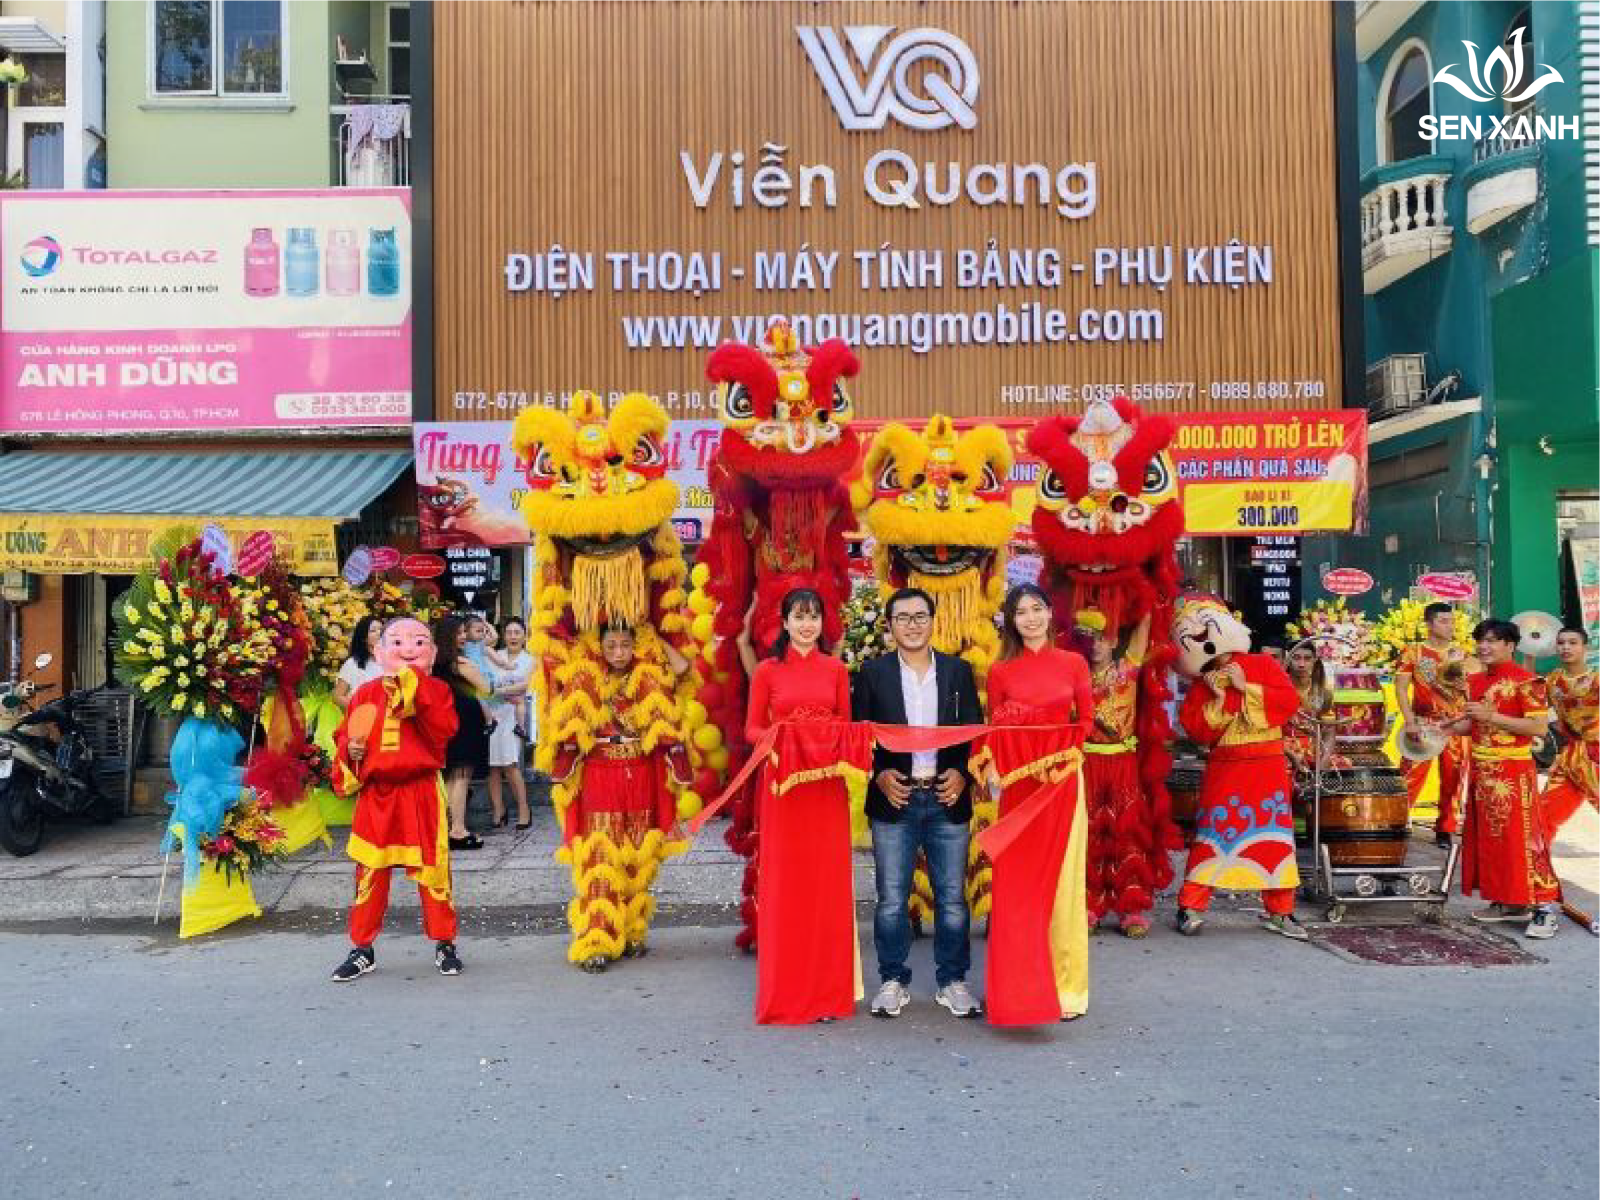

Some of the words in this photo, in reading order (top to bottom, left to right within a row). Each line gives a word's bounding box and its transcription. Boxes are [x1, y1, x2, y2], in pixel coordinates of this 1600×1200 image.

[680, 142, 837, 208] Viễn
[863, 149, 1098, 219] Quang
[71, 248, 218, 265] TOTALGAZ
[505, 244, 595, 298] ĐIỆN
[606, 251, 721, 298] THOẠI
[755, 243, 838, 290] MÁY
[853, 242, 943, 290] TÍNH
[957, 239, 1061, 289] BẢNG
[1094, 245, 1174, 291] PHỤ
[1186, 238, 1273, 290] KIỆN
[18, 363, 107, 387] ANH
[119, 356, 239, 387] DŨNG
[1263, 416, 1301, 449] TRỞ
[1307, 418, 1345, 448] LÊN
[1180, 458, 1209, 479] CÁC
[1236, 505, 1299, 527] 300.000
